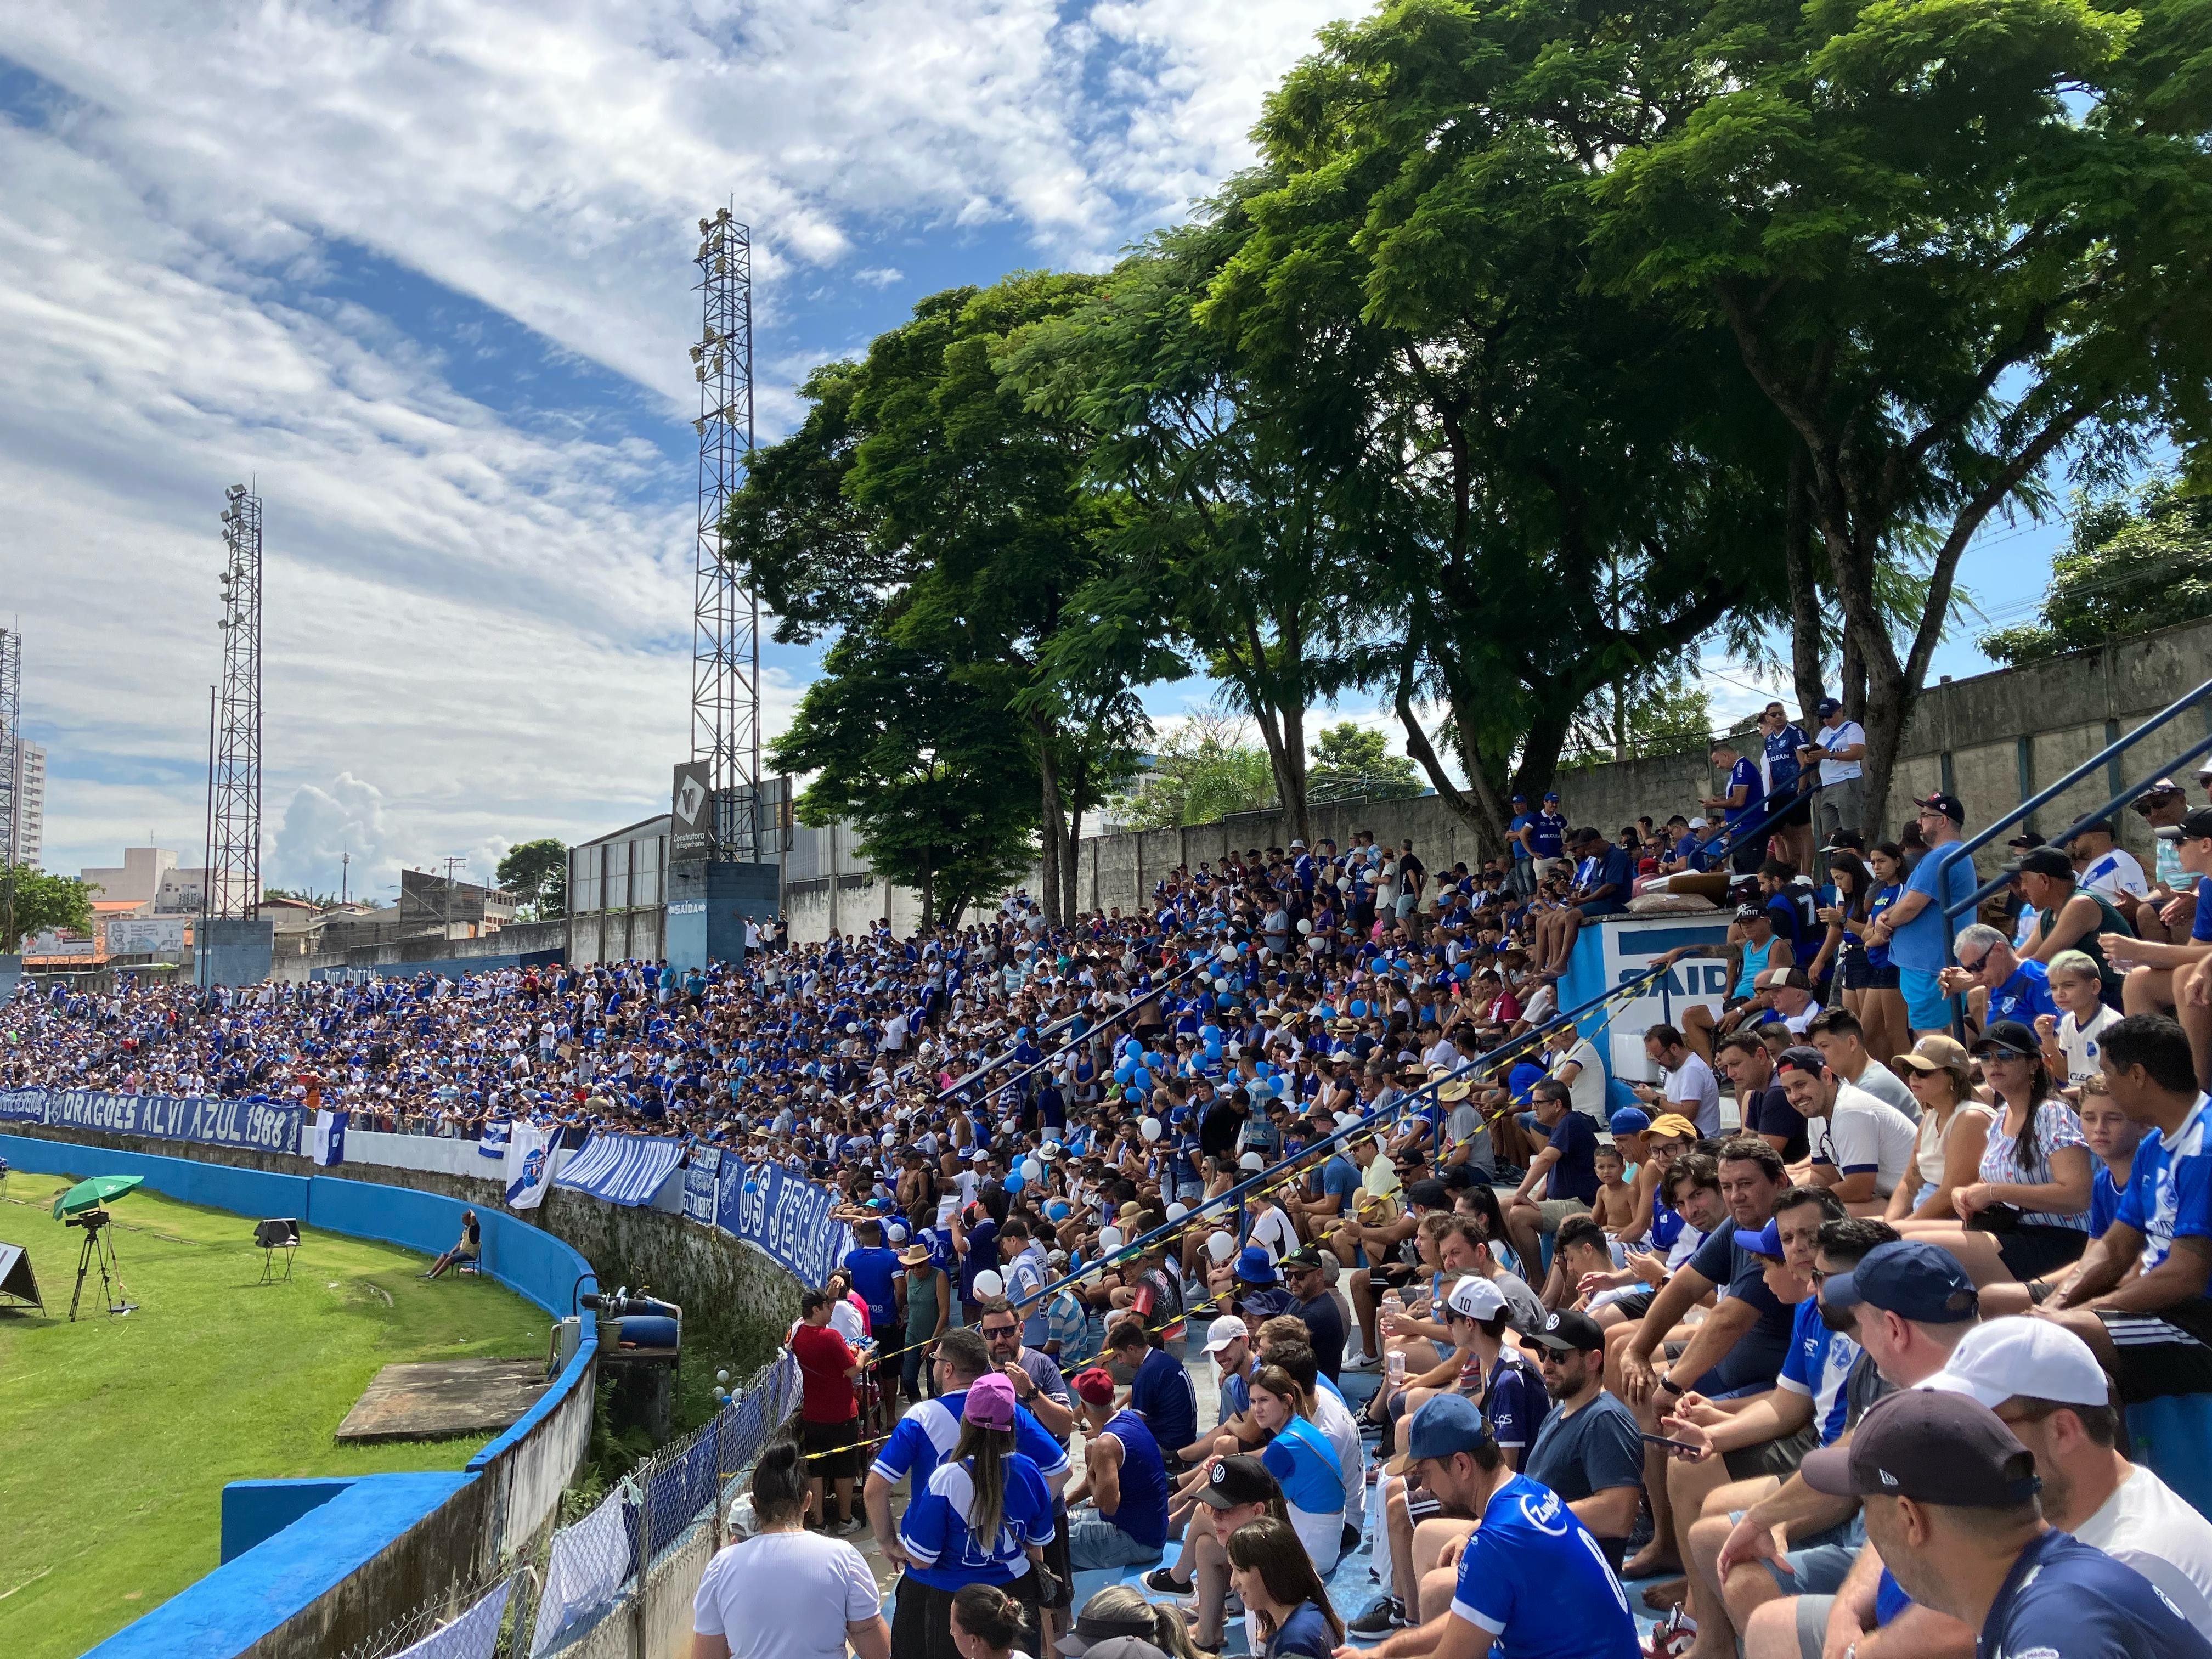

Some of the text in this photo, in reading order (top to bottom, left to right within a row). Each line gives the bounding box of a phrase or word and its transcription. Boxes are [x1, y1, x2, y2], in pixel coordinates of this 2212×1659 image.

[674, 832, 705, 843] Construtora
[680, 839, 704, 850] Engenharia
[675, 900, 698, 915] SAÍDA
[1796, 893, 1816, 926] 7
[142, 1098, 185, 1135] ALVI
[188, 1101, 241, 1141] AZUL
[245, 1105, 286, 1148] 1988
[738, 1164, 832, 1288] OS JECAS
[1459, 1296, 1471, 1312] 10
